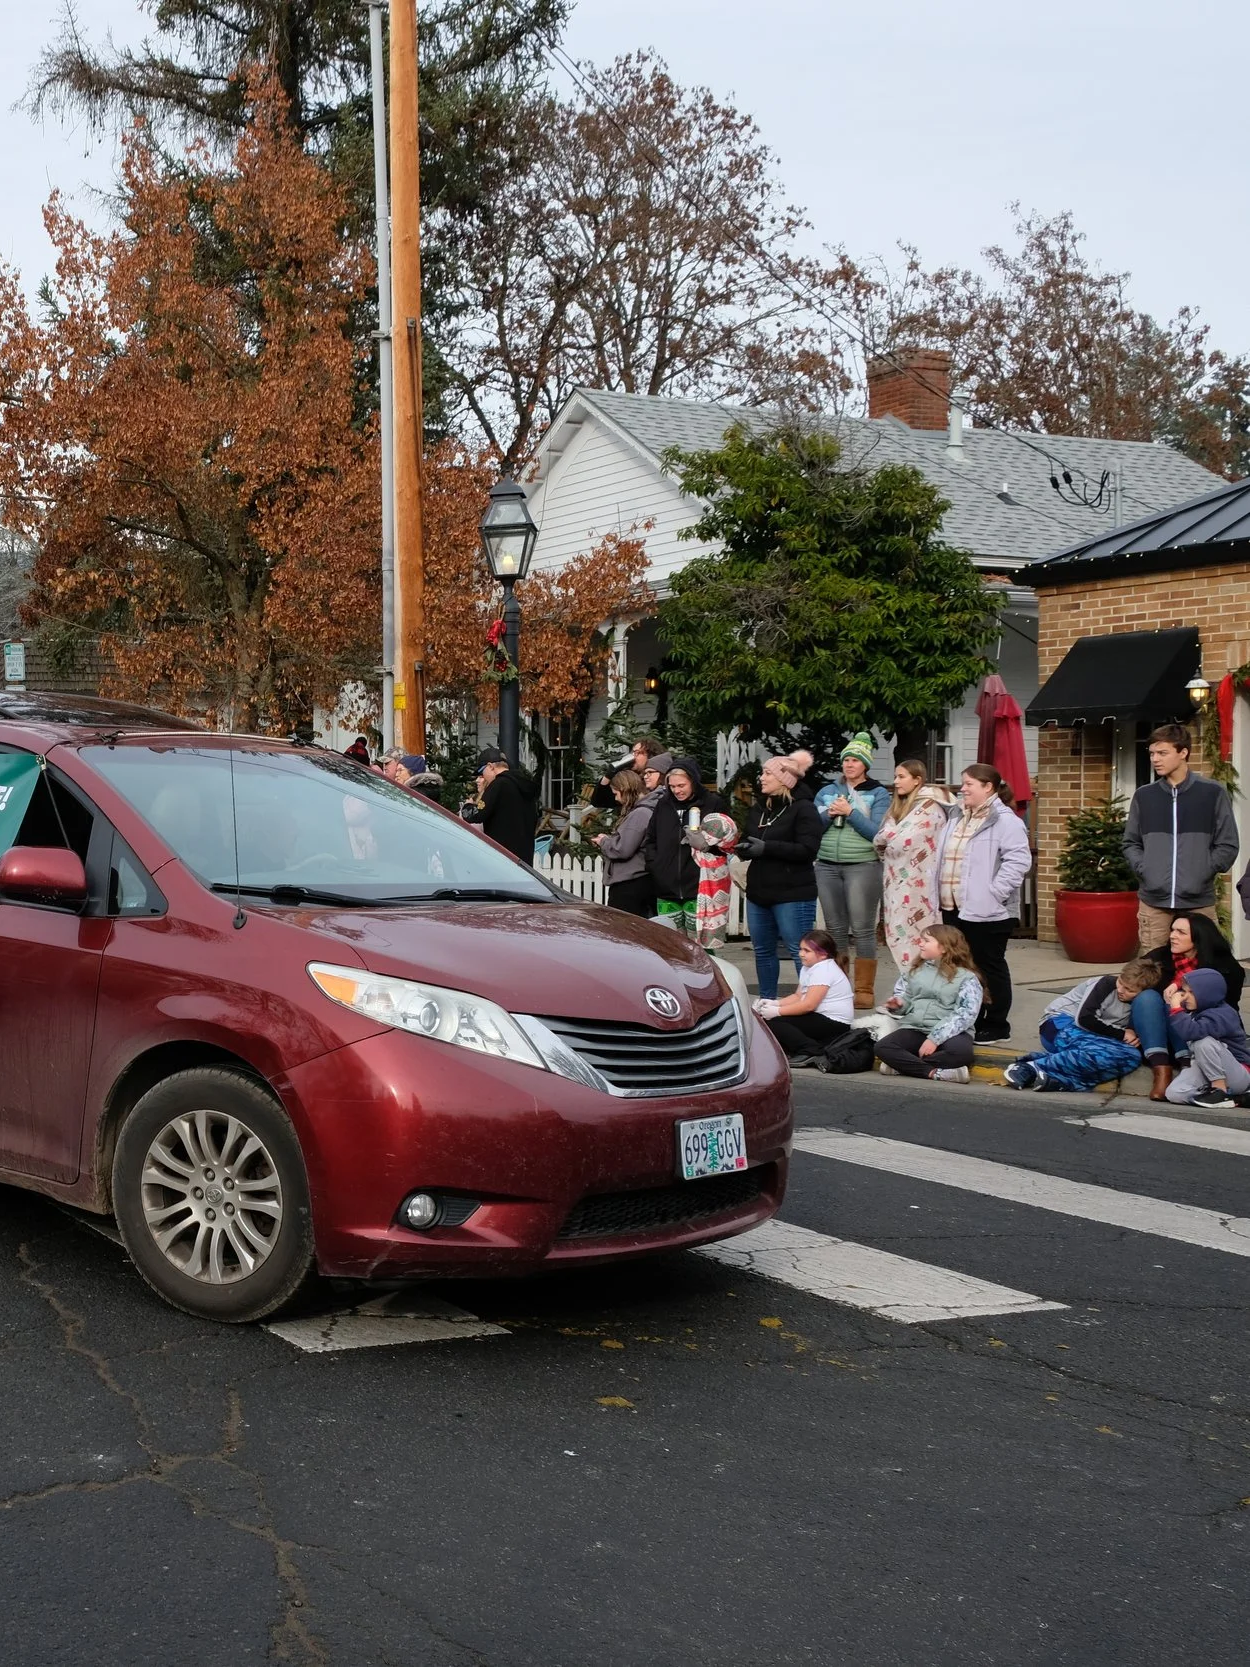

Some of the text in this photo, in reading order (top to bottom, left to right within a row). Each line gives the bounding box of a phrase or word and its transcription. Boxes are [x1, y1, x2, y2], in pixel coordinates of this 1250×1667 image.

[698, 1120, 722, 1131] Oregon
[685, 1127, 741, 1165] 699 GGV
